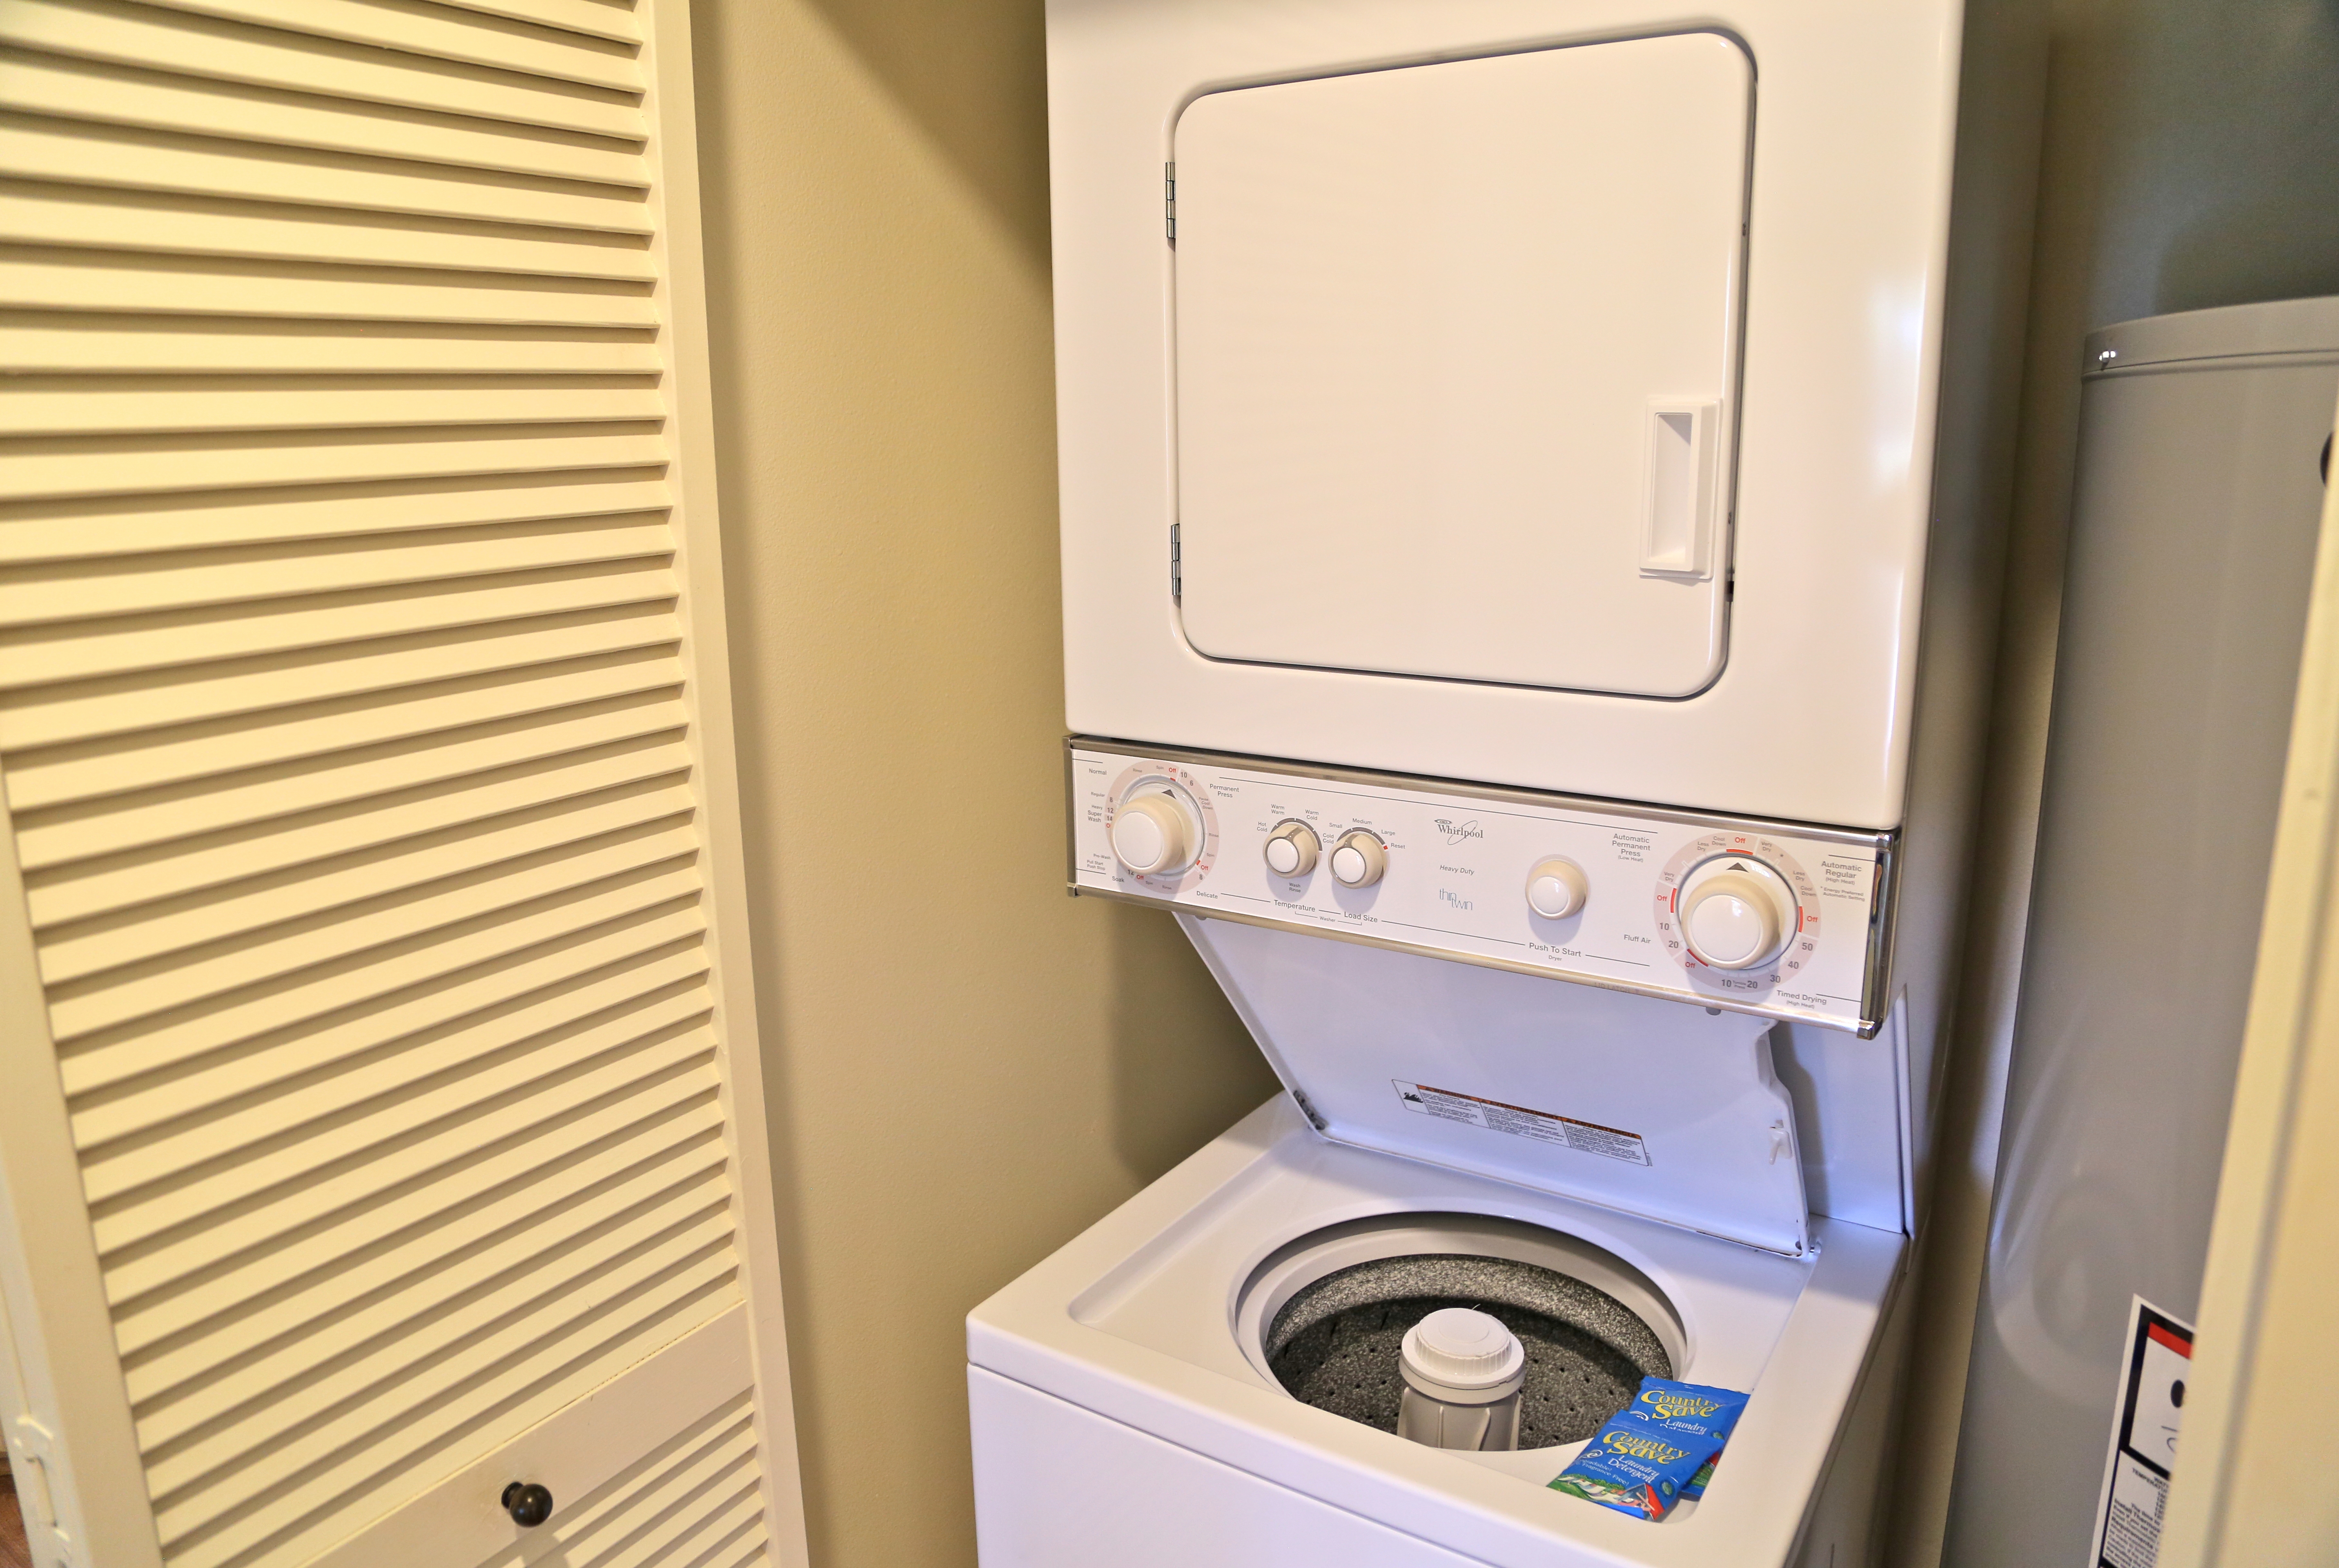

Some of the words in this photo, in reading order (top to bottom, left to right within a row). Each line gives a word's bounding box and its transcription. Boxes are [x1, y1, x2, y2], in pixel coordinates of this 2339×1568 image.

[1210, 784, 1239, 792] Permanent
[1437, 824, 1484, 839] Whirlpool
[1613, 833, 1650, 843] Automatic
[1612, 840, 1651, 851] Permanent
[1440, 864, 1458, 873] Heavy
[1460, 867, 1475, 875] Duty
[1821, 861, 1862, 872] Automatic
[1826, 869, 1857, 878] Regular
[1196, 891, 1218, 899] Delicate
[1274, 899, 1316, 912] Temperature
[1344, 911, 1361, 920] Load
[1363, 915, 1378, 923] Size
[1660, 922, 1669, 931] 10
[1624, 934, 1639, 942] Fluff
[1529, 942, 1548, 951] Push
[1562, 948, 1581, 957] Start
[1668, 940, 1679, 949] 20
[1802, 942, 1813, 951] 50
[1788, 961, 1799, 969] 40
[1722, 979, 1731, 987] 10
[1747, 980, 1758, 989] 20
[1770, 975, 1781, 983] 30
[1777, 990, 1800, 999] Timed
[1802, 994, 1827, 1005] Drying
[1641, 1390, 1726, 1410] Country
[1652, 1404, 1715, 1419] Save
[1666, 1419, 1707, 1434] Laundry
[1603, 1431, 1691, 1459] Country
[1607, 1441, 1675, 1465] Save
[1608, 1458, 1654, 1483] Detergent
[1618, 1455, 1660, 1477] Laundry
[1613, 1474, 1629, 1486] Free!
